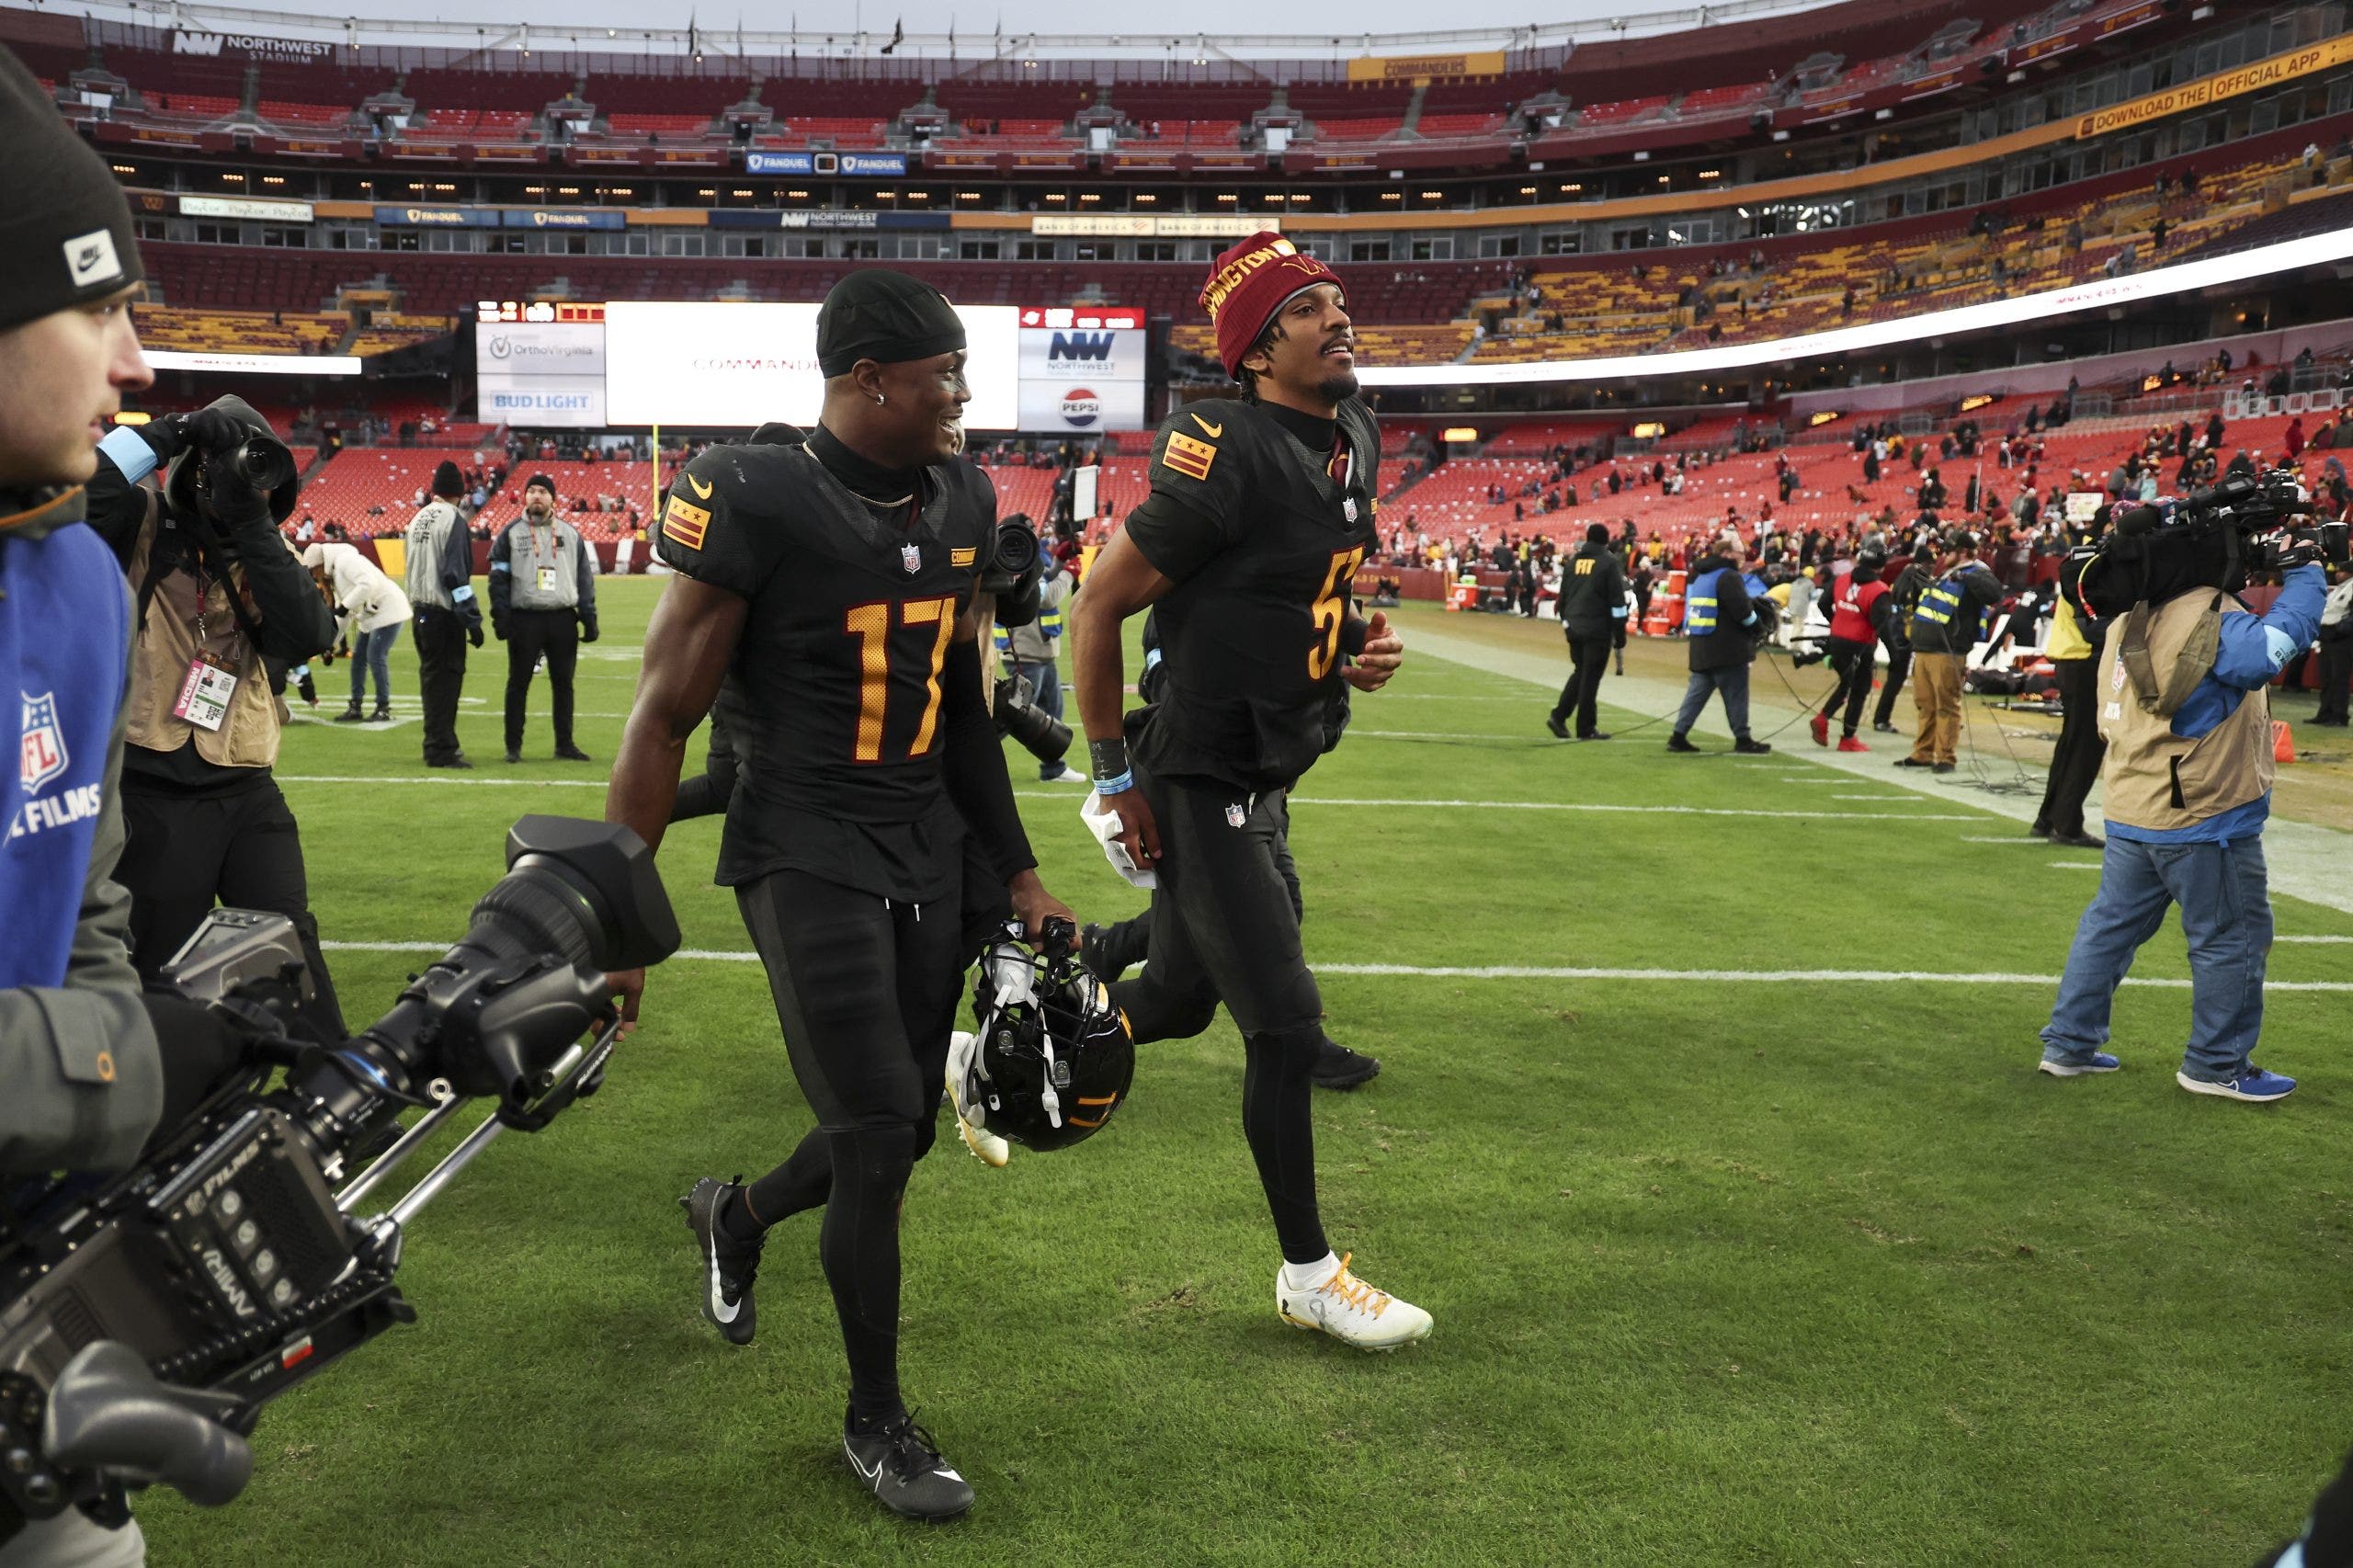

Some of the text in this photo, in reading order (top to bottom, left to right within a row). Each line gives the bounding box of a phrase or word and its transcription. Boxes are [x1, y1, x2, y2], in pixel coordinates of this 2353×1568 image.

[173, 31, 332, 56] NW NORTHWEST
[249, 50, 313, 64] STADIUM
[1385, 61, 1467, 75] COMMANDERS
[2096, 51, 2321, 131] DOWNLOAD THE OFFICIAL APP
[764, 157, 811, 169] FANDUEL
[857, 159, 904, 170] FANDUEL
[422, 211, 464, 222] FANDUEL
[548, 214, 589, 225] FANDUEL
[811, 212, 878, 222] NORTHWEST
[514, 344, 593, 358] OrthoVirginia
[1049, 333, 1115, 360] NW
[1048, 361, 1115, 369] NORTHWEST
[494, 395, 588, 408] BUD LIGHT
[1063, 403, 1099, 412] PEPSI
[905, 557, 918, 569] NFL
[1574, 559, 1596, 575] FIT
[1308, 541, 1365, 681] 5
[844, 595, 958, 764] 17
[178, 667, 200, 710] MEDIA
[25, 783, 101, 834] FILMS
[203, 1140, 259, 1198] FILMS
